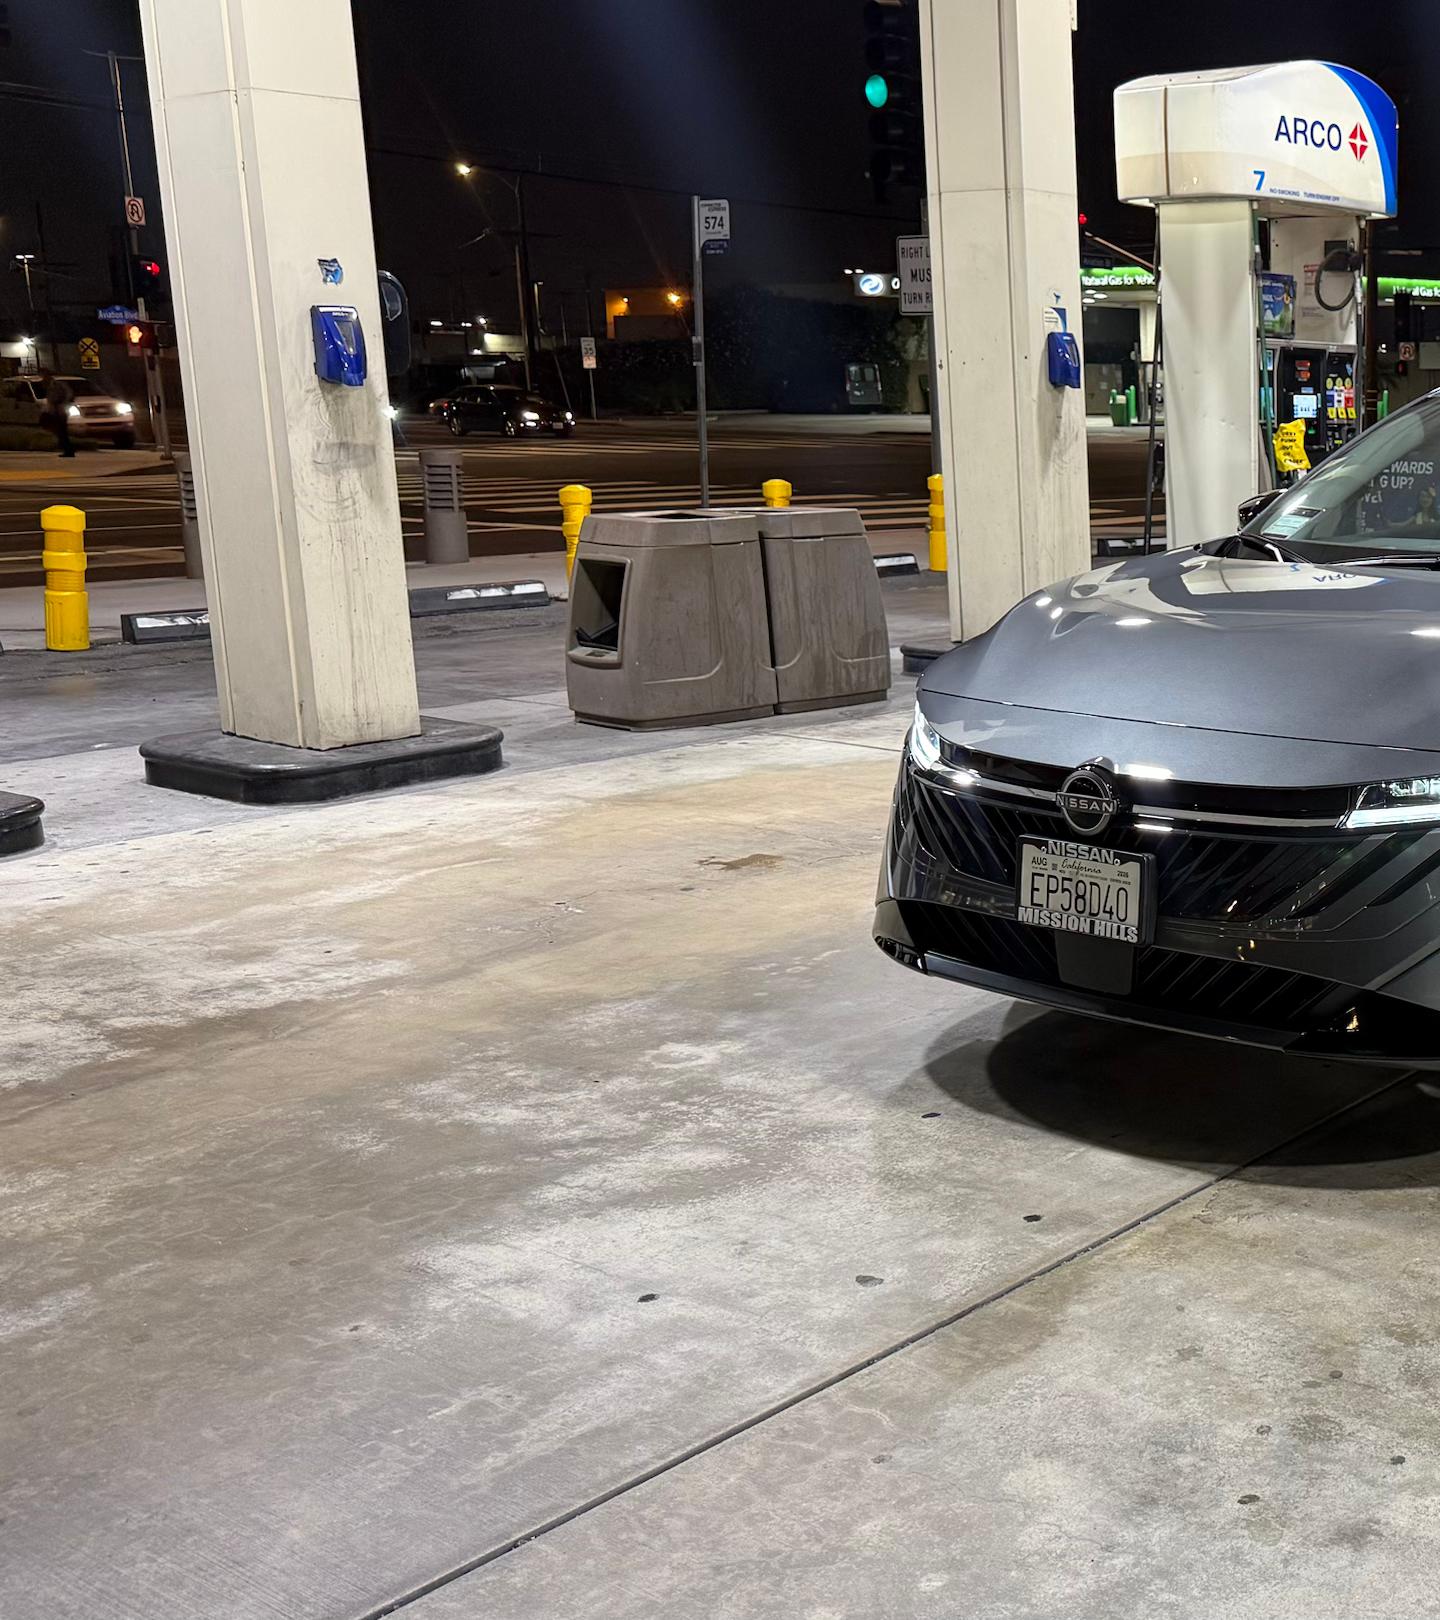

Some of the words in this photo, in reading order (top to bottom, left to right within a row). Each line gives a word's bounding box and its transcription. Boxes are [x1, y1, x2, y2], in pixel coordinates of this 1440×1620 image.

[1274, 115, 1342, 151] ARCO
[1253, 170, 1266, 191] 7
[704, 216, 724, 230] 574
[901, 247, 923, 259] RIGHT
[910, 268, 932, 282] MUS
[1109, 275, 1123, 286] Gas
[1124, 273, 1134, 286] for
[1135, 274, 1156, 286] Vehic
[903, 292, 923, 304] TURN
[1420, 287, 1433, 297] Gas
[98, 309, 124, 319] Aviation
[1383, 461, 1434, 474] WARDS
[1391, 475, 1415, 489] UP?
[1056, 793, 1114, 813] NISSAN
[1049, 841, 1115, 866] NISSAN
[1031, 856, 1048, 867] AUG
[1061, 858, 1102, 875] California
[1030, 872, 1129, 923] EP58D40
[1017, 906, 1091, 934] MISSION
[1094, 916, 1139, 944] HILLS
